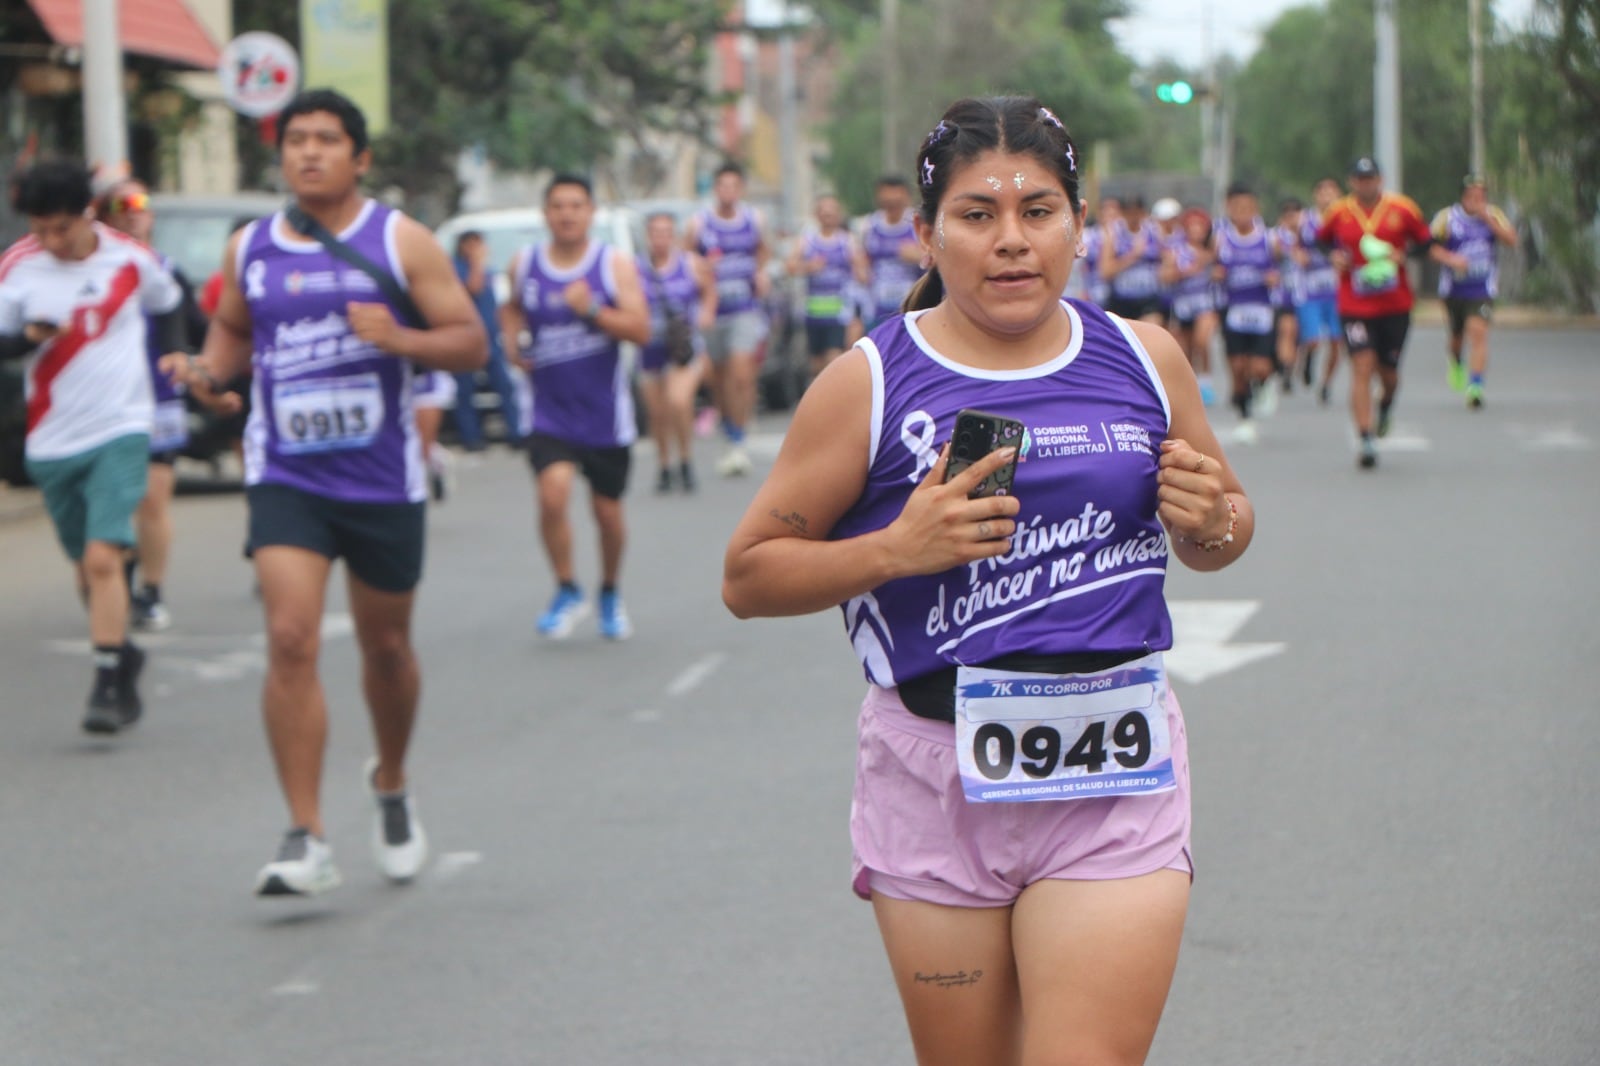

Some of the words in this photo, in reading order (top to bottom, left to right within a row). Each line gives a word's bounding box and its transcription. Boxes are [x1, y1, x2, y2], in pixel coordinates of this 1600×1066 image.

[289, 404, 368, 441] 0913
[1033, 424, 1089, 436] GOBIERNO
[1036, 434, 1091, 446] REGIONAL
[1117, 441, 1131, 452] DE
[1038, 447, 1052, 458] LA
[1053, 443, 1106, 456] LIBERTAD
[926, 583, 949, 637] el
[952, 564, 1042, 626] cáncer
[1049, 551, 1096, 588] no
[1094, 530, 1168, 573] avisa
[991, 682, 1013, 697] 7K
[1022, 684, 1042, 695] YO
[1043, 682, 1089, 695] CORRO
[1090, 678, 1113, 691] POR
[973, 710, 1152, 781] 0949
[981, 788, 1021, 799] GERENCIA
[1021, 785, 1062, 796] REGIONAL
[1062, 783, 1075, 793] DE
[1075, 781, 1104, 791] SALUD
[1104, 779, 1117, 788] LA
[1116, 777, 1158, 787] LIBERTAD
